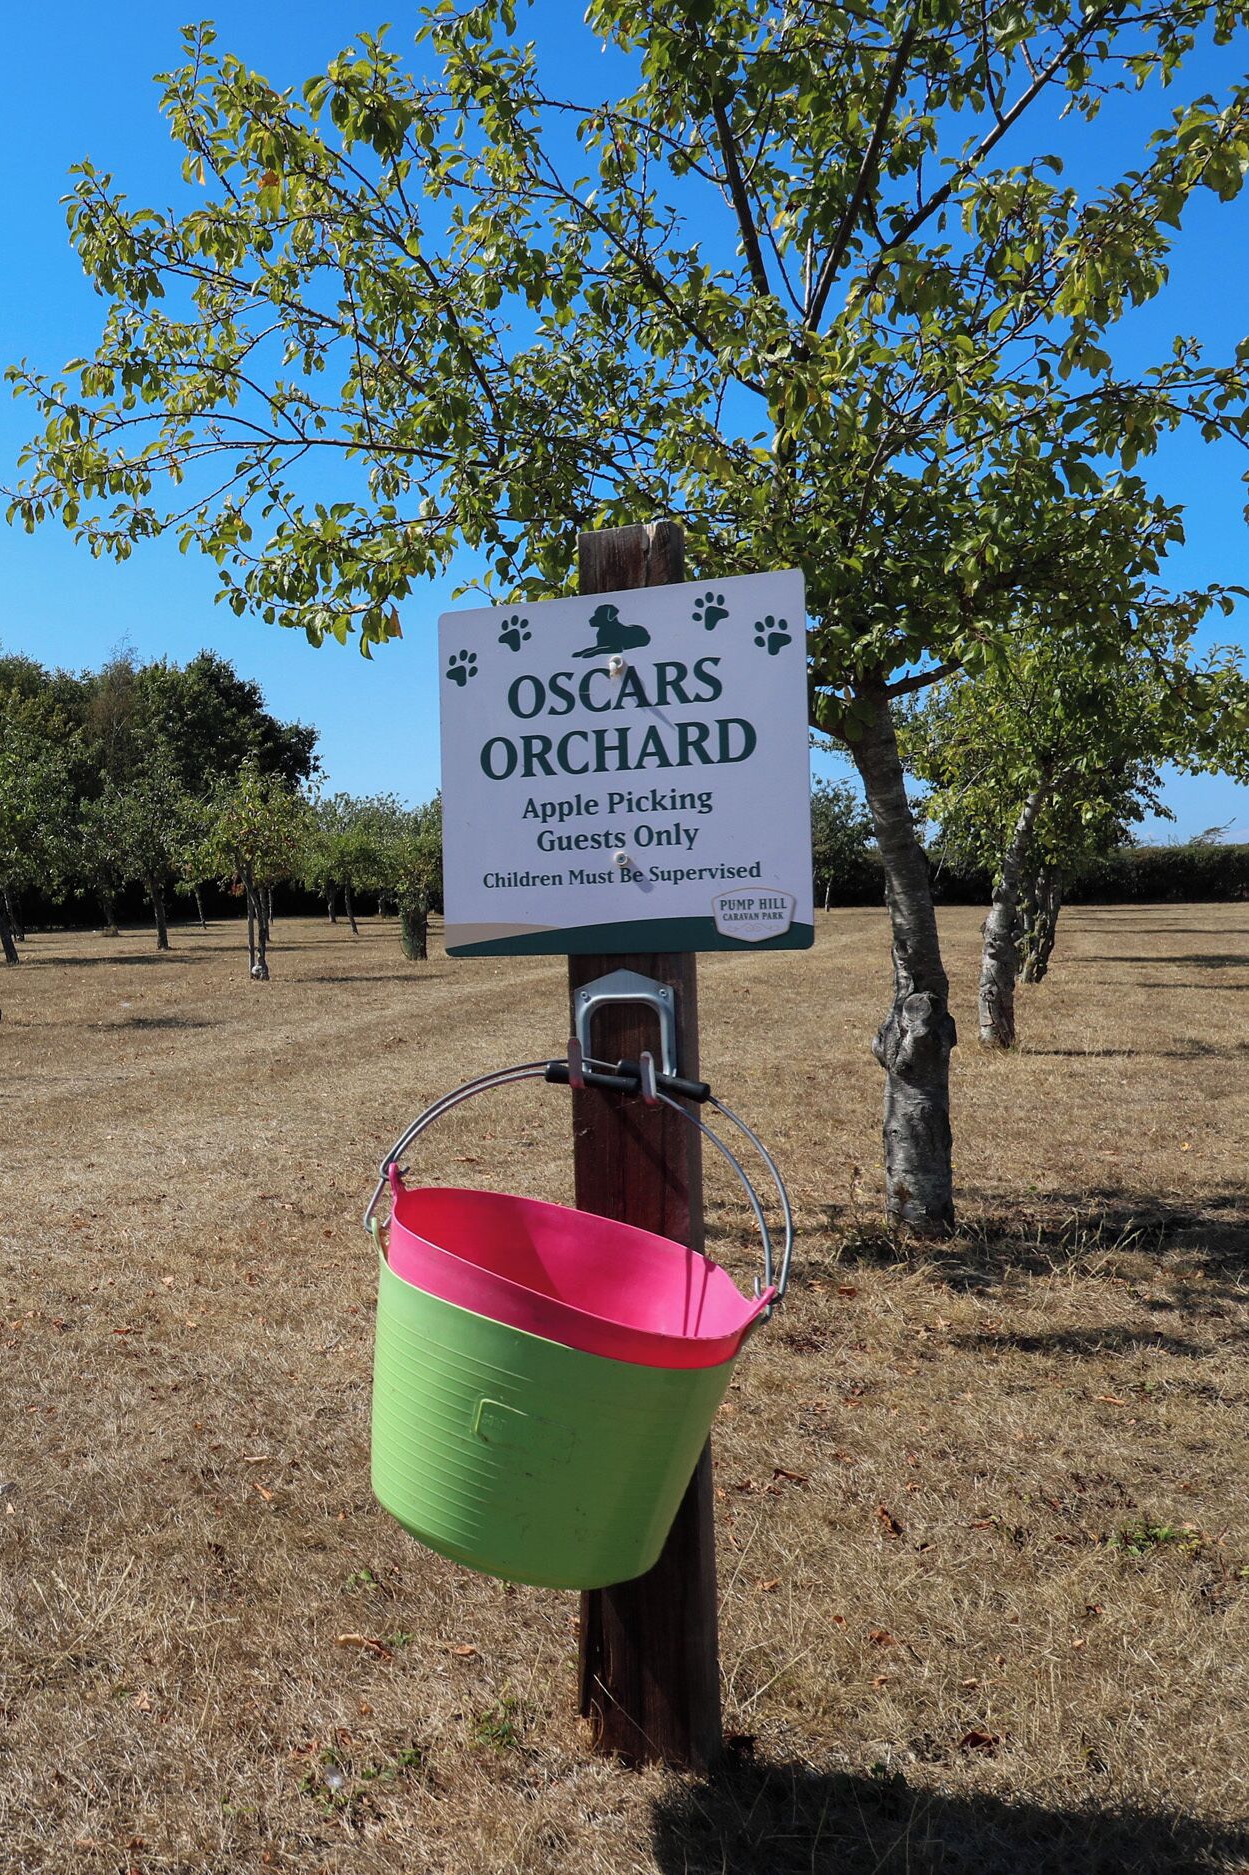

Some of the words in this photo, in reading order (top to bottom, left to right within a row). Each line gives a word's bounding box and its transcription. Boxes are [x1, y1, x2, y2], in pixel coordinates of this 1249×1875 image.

[508, 657, 723, 719] OSCARS
[480, 718, 756, 780] ORCHARD
[522, 794, 599, 823] Apple
[607, 788, 713, 813] Picking
[537, 832, 625, 851] Guests
[634, 823, 699, 850] Only
[483, 872, 563, 888] Children
[569, 869, 614, 884] Must
[620, 867, 643, 882] Be
[649, 862, 761, 884] Supervised
[720, 899, 754, 910] PUMP
[759, 898, 787, 909] HILL
[723, 913, 759, 921] CARAVAN
[762, 912, 783, 920] PARK
